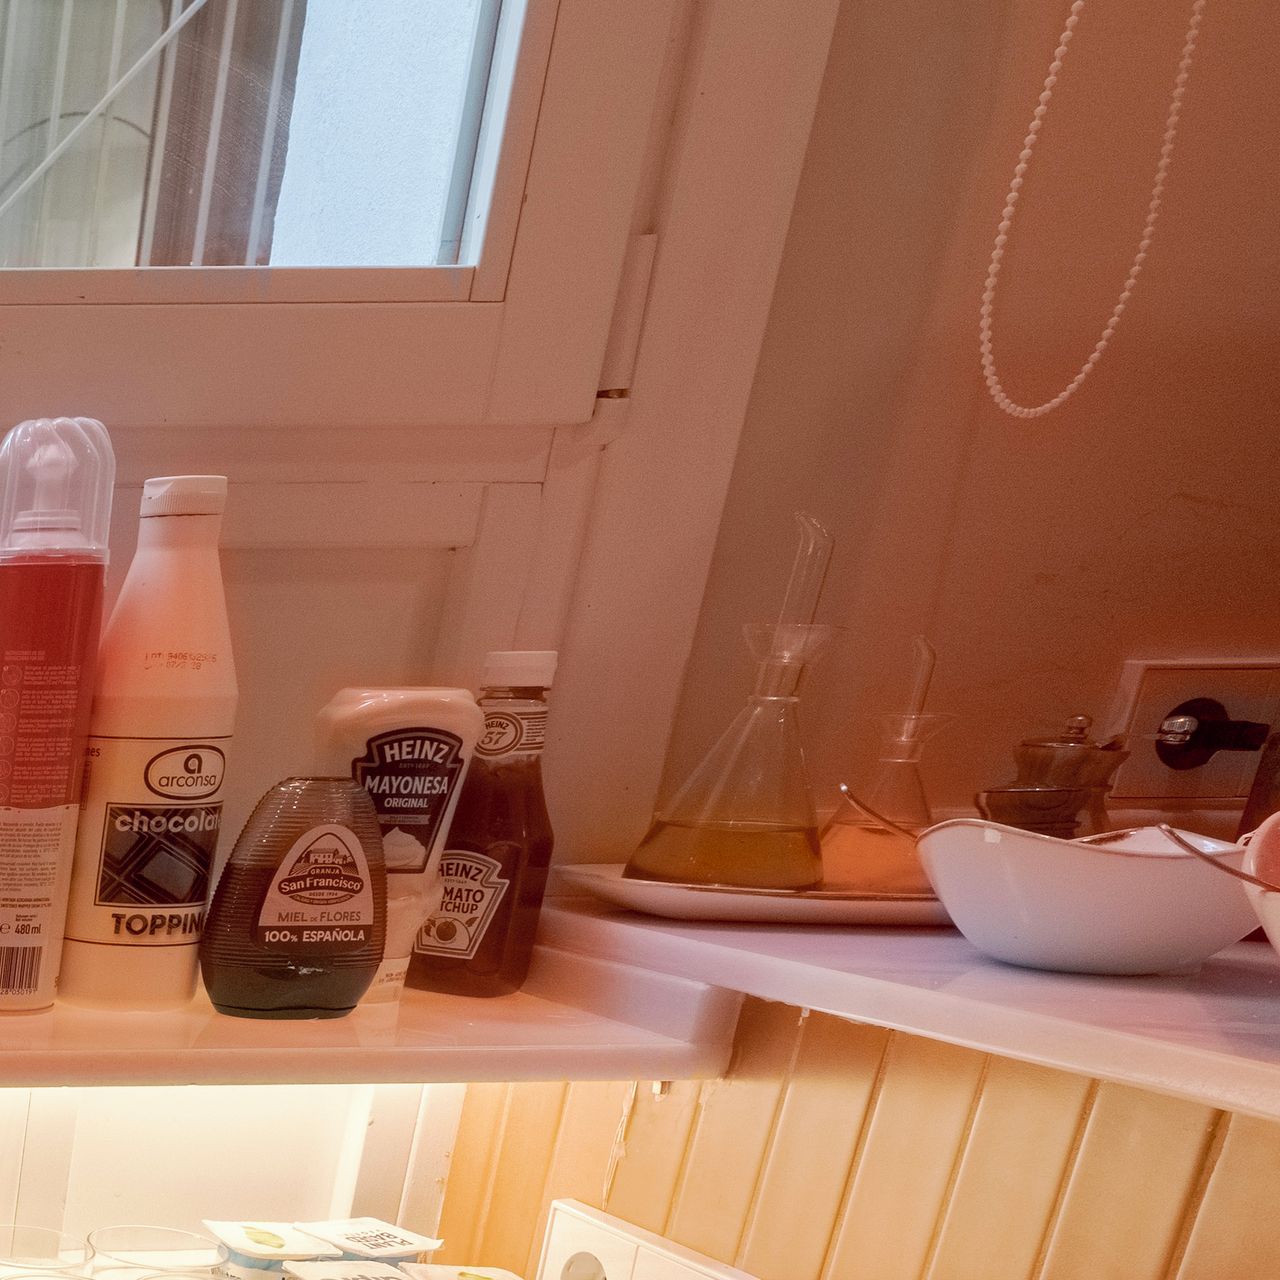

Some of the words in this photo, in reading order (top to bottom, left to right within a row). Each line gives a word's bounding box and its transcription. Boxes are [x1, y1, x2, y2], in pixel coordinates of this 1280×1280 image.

[485, 720, 509, 730] HEINZ
[480, 731, 507, 746] 57
[383, 740, 450, 763] HEINZ
[158, 774, 217, 787] arconsa
[364, 776, 449, 794] MAYONESA
[383, 798, 429, 808] ORIGINAL
[280, 880, 304, 893] San
[306, 877, 361, 891] Francisco
[442, 886, 485, 903] MATO
[278, 912, 308, 922] MIEL
[320, 911, 361, 922] FLORES
[264, 930, 298, 942] 100%
[303, 929, 365, 942] ESPAÑOLA
